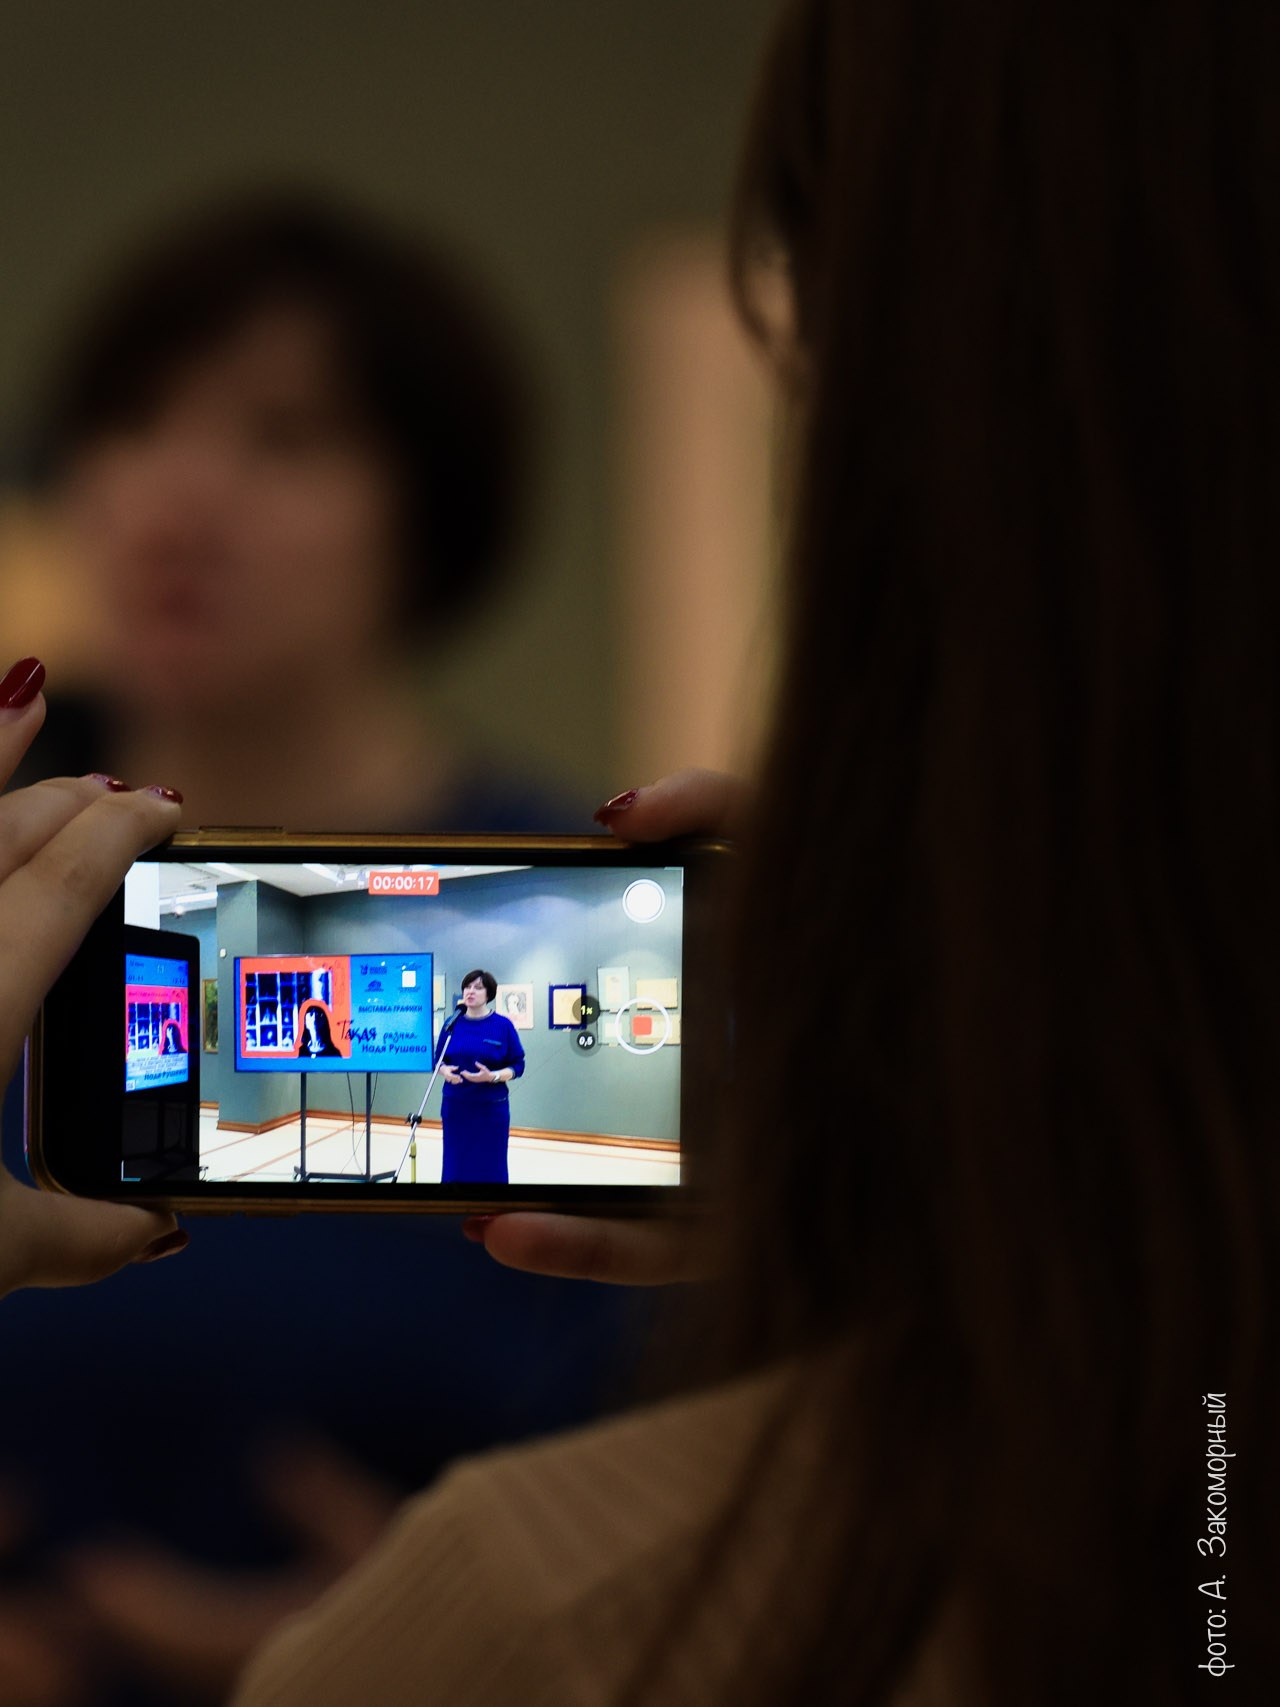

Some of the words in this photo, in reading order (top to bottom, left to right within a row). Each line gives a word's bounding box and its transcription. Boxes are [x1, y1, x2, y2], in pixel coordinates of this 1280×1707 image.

[372, 876, 435, 890] 00:00:17
[359, 1005, 392, 1013] ВЫСТАВКА
[393, 1005, 422, 1013] ГРАФИКИ
[579, 1036, 593, 1047] 0,5
[362, 1045, 387, 1054] Надя
[389, 1043, 428, 1055] Рушева
